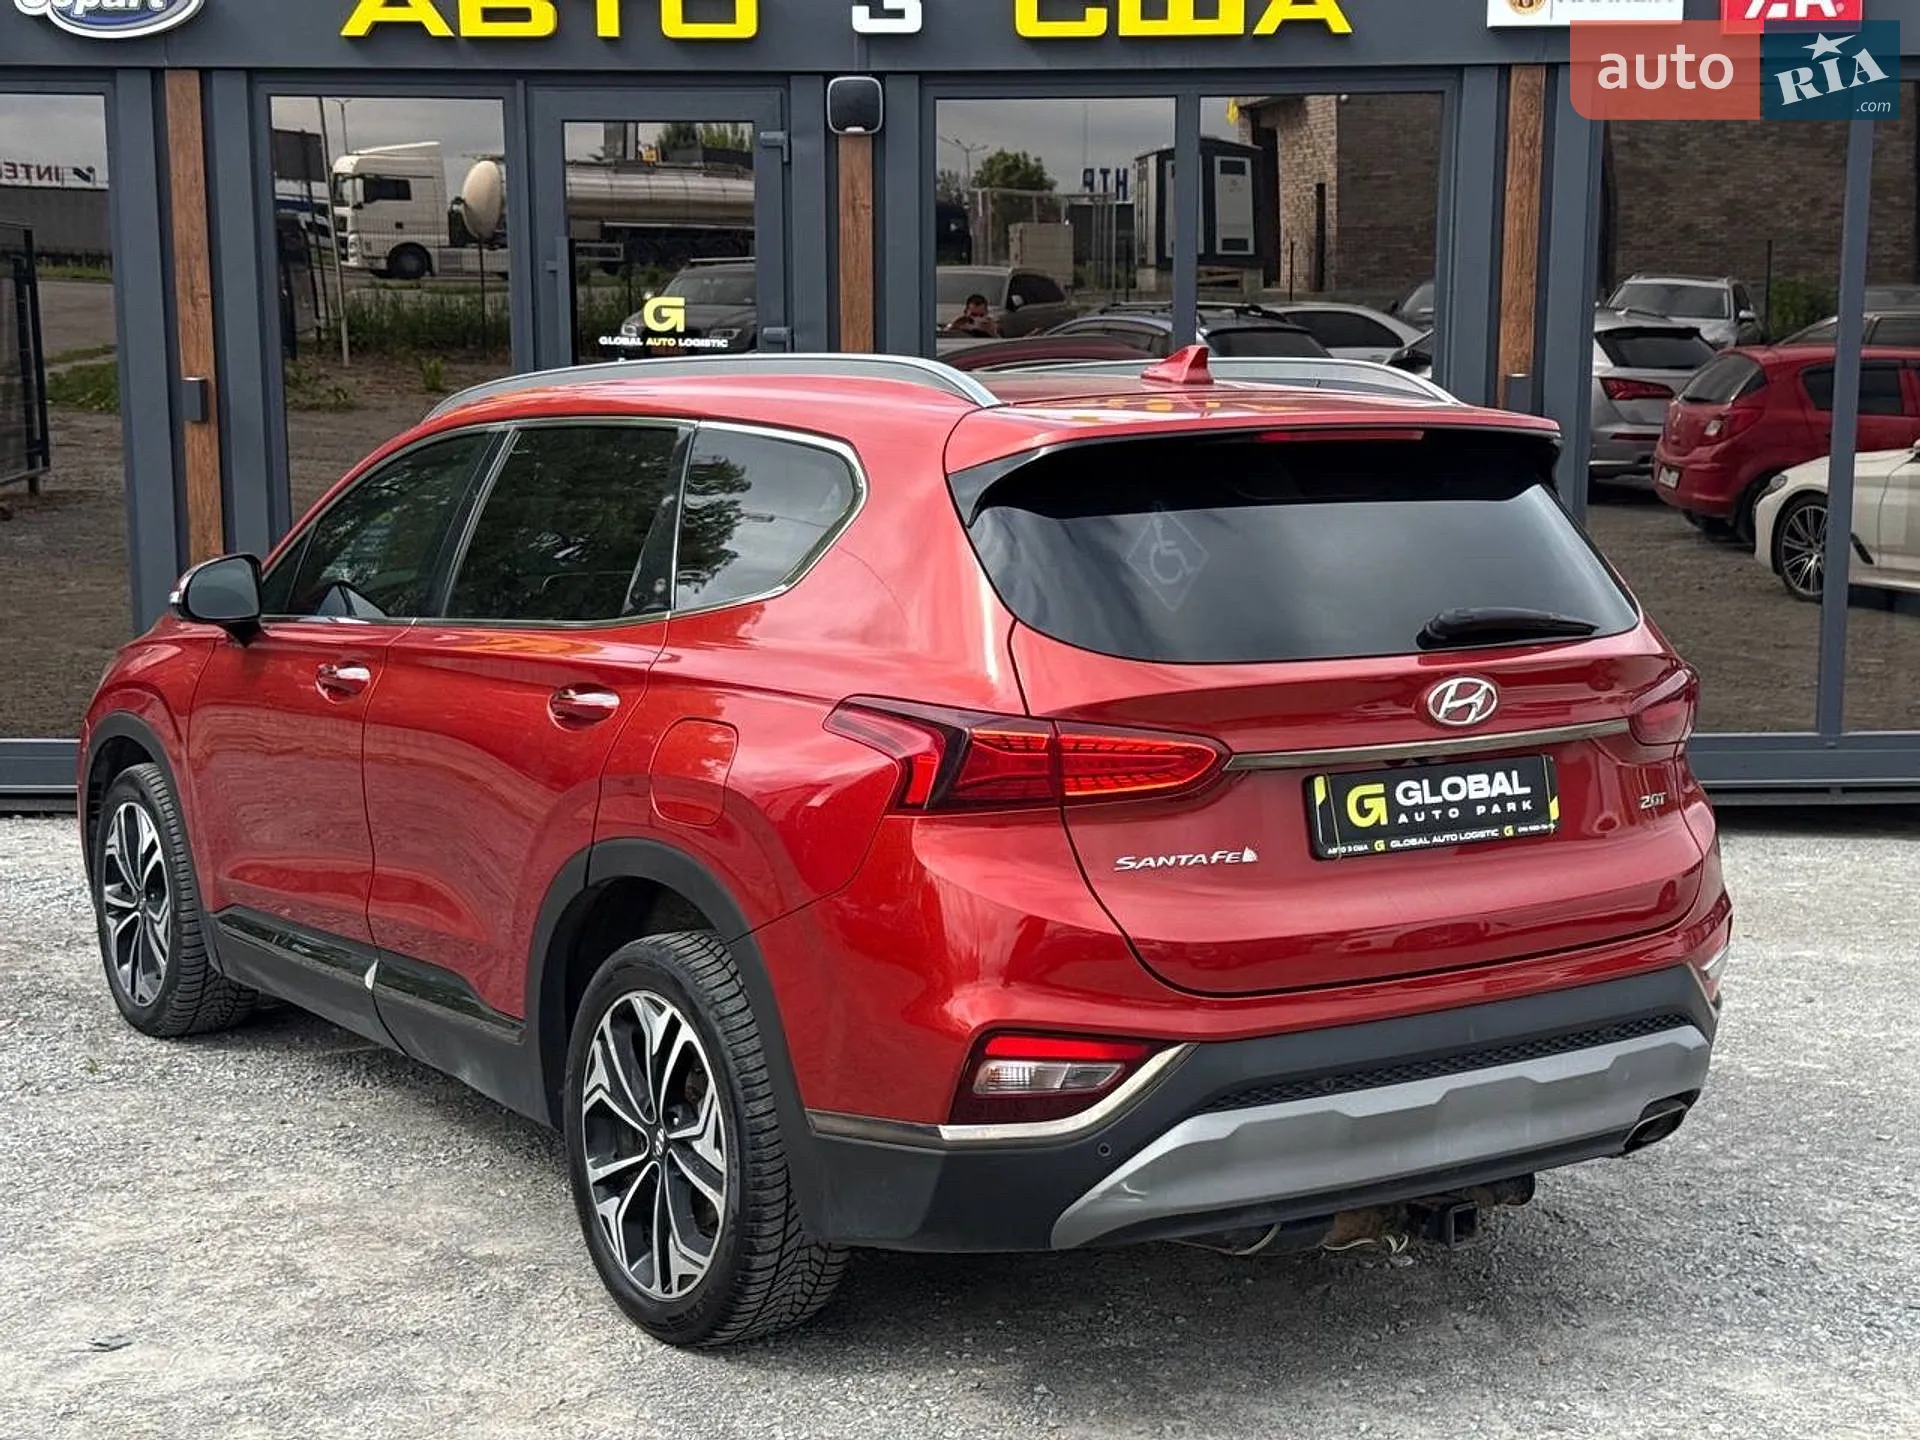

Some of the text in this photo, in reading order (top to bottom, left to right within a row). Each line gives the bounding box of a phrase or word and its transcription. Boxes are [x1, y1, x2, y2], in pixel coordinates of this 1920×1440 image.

[598, 336, 728, 348] GLOBAL AUTO LOGISTIC
[1395, 770, 1531, 806] GLOBAL
[1398, 800, 1532, 824] AUTO PARK
[1390, 828, 1499, 849] GLOBAL AUTO LOGISTIC
